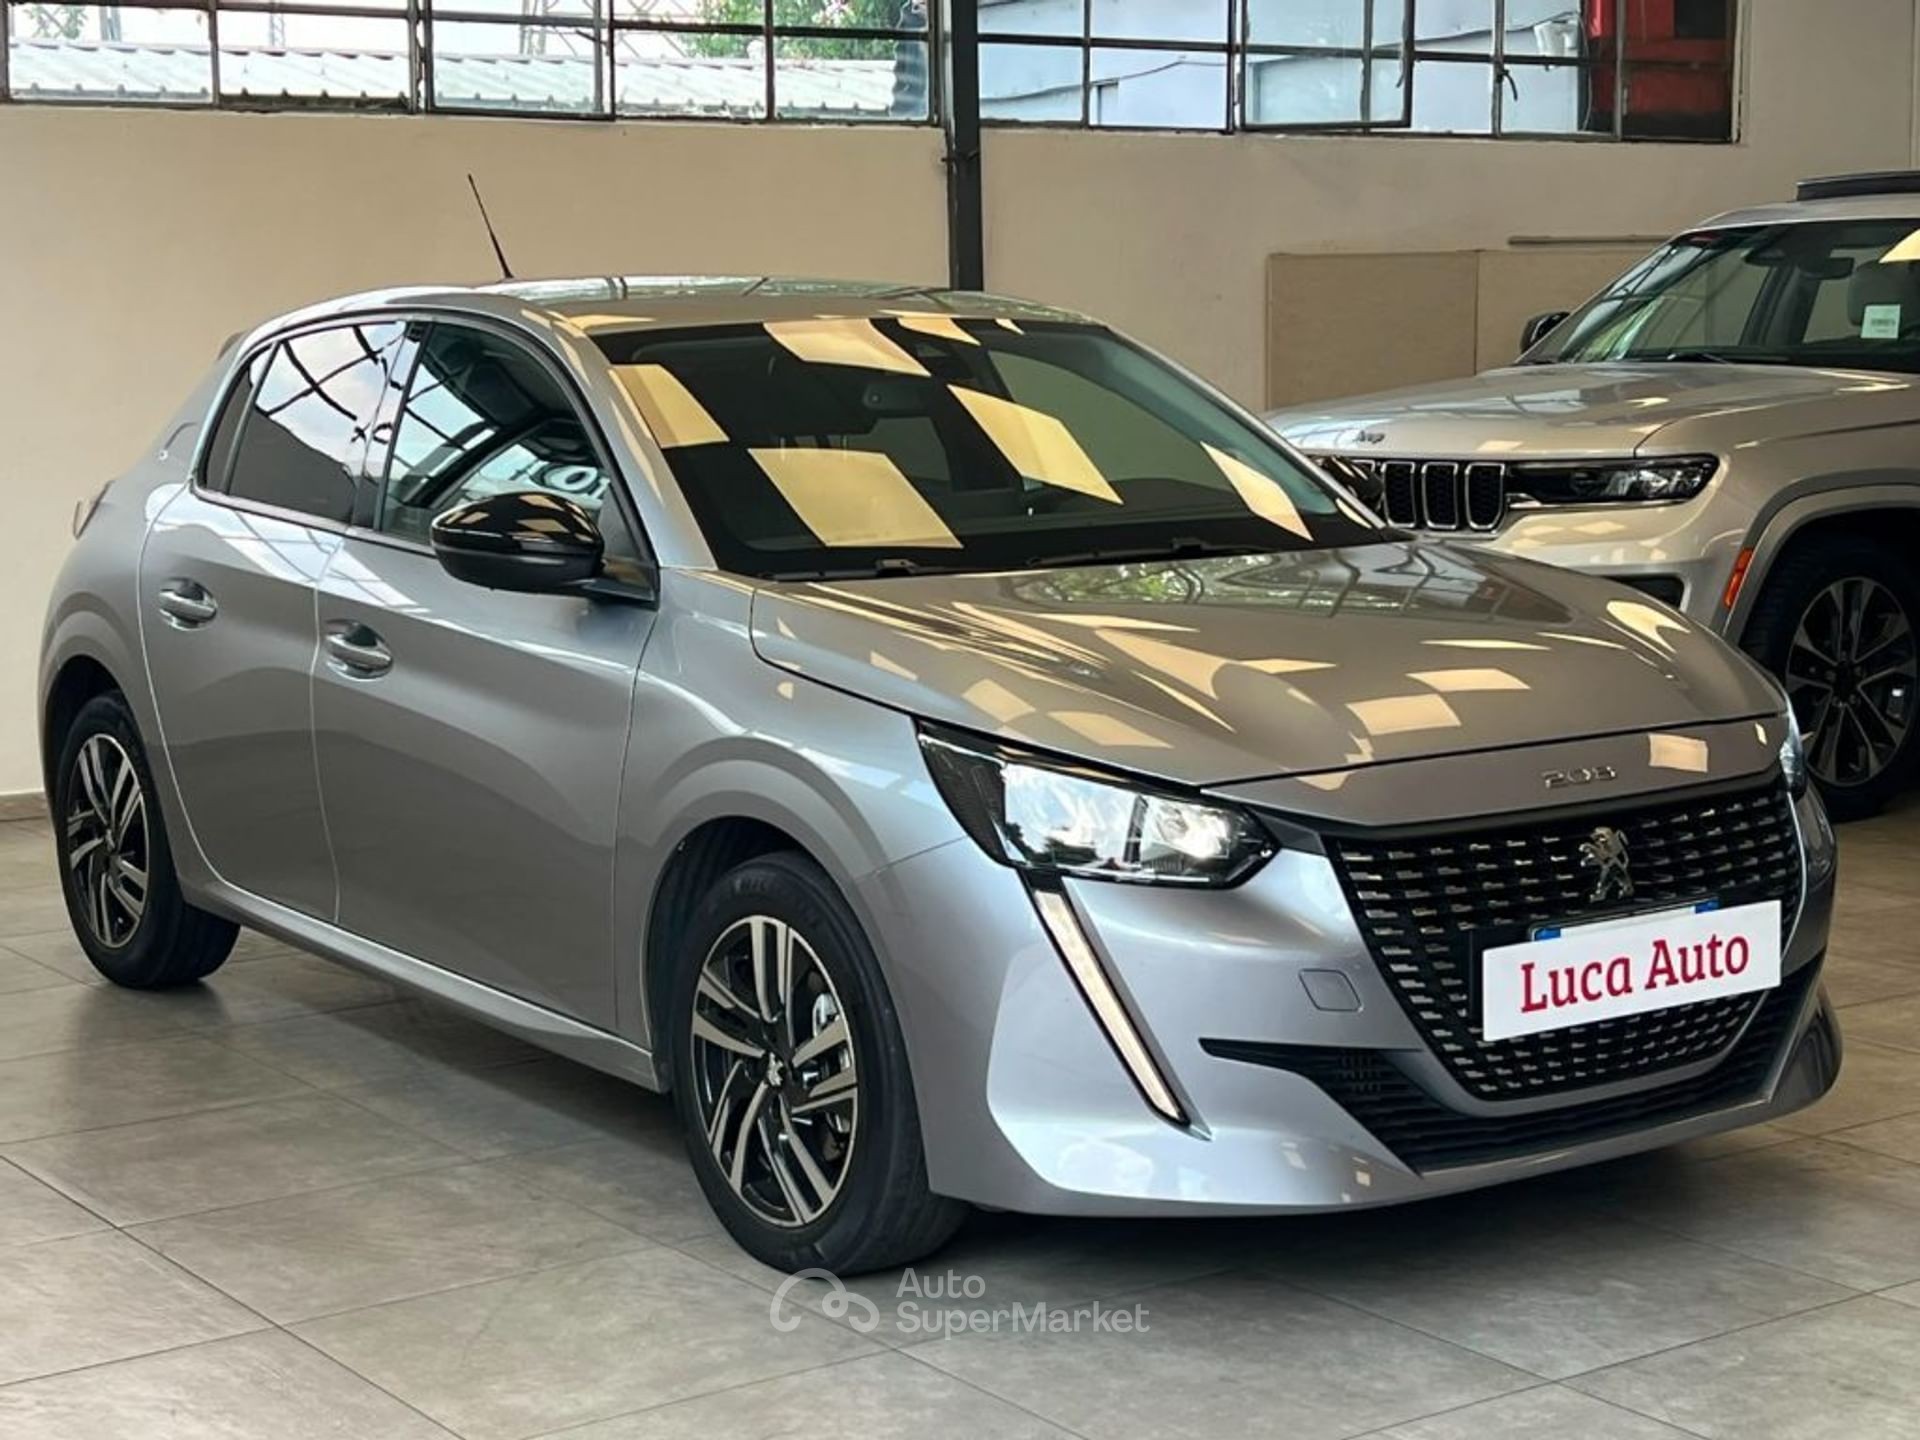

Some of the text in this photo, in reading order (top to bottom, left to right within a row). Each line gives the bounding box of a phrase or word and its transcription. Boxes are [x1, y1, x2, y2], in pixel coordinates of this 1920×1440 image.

[1541, 766, 1617, 789] 208
[1520, 933, 1749, 1014] Luca Auto
